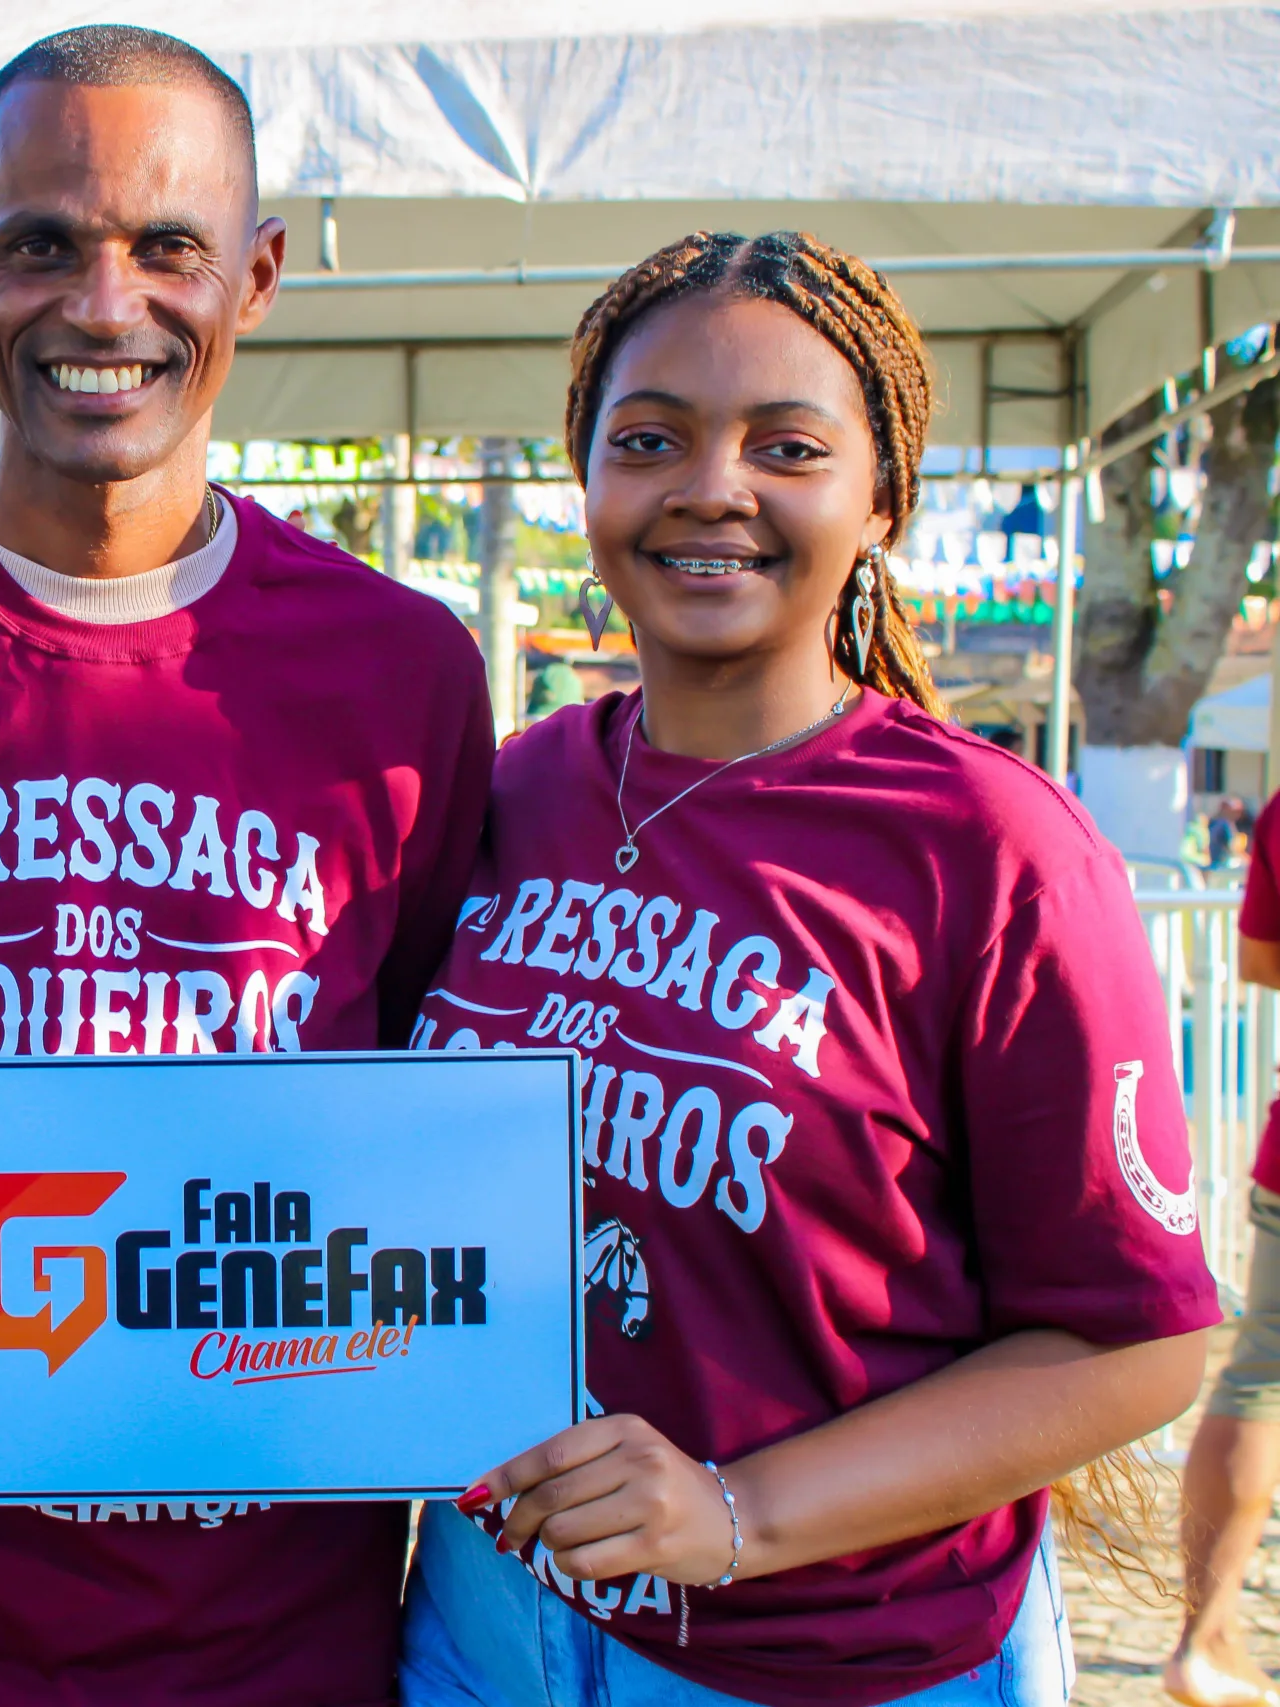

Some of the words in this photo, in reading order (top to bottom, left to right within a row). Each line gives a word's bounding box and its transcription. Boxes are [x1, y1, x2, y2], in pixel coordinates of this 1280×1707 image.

[53, 903, 144, 960] DOS
[480, 878, 836, 1078] RESSACA
[527, 992, 620, 1049] DOS
[183, 1178, 311, 1244] Fala
[189, 1331, 340, 1380] Chama
[346, 1314, 418, 1361] ele!
